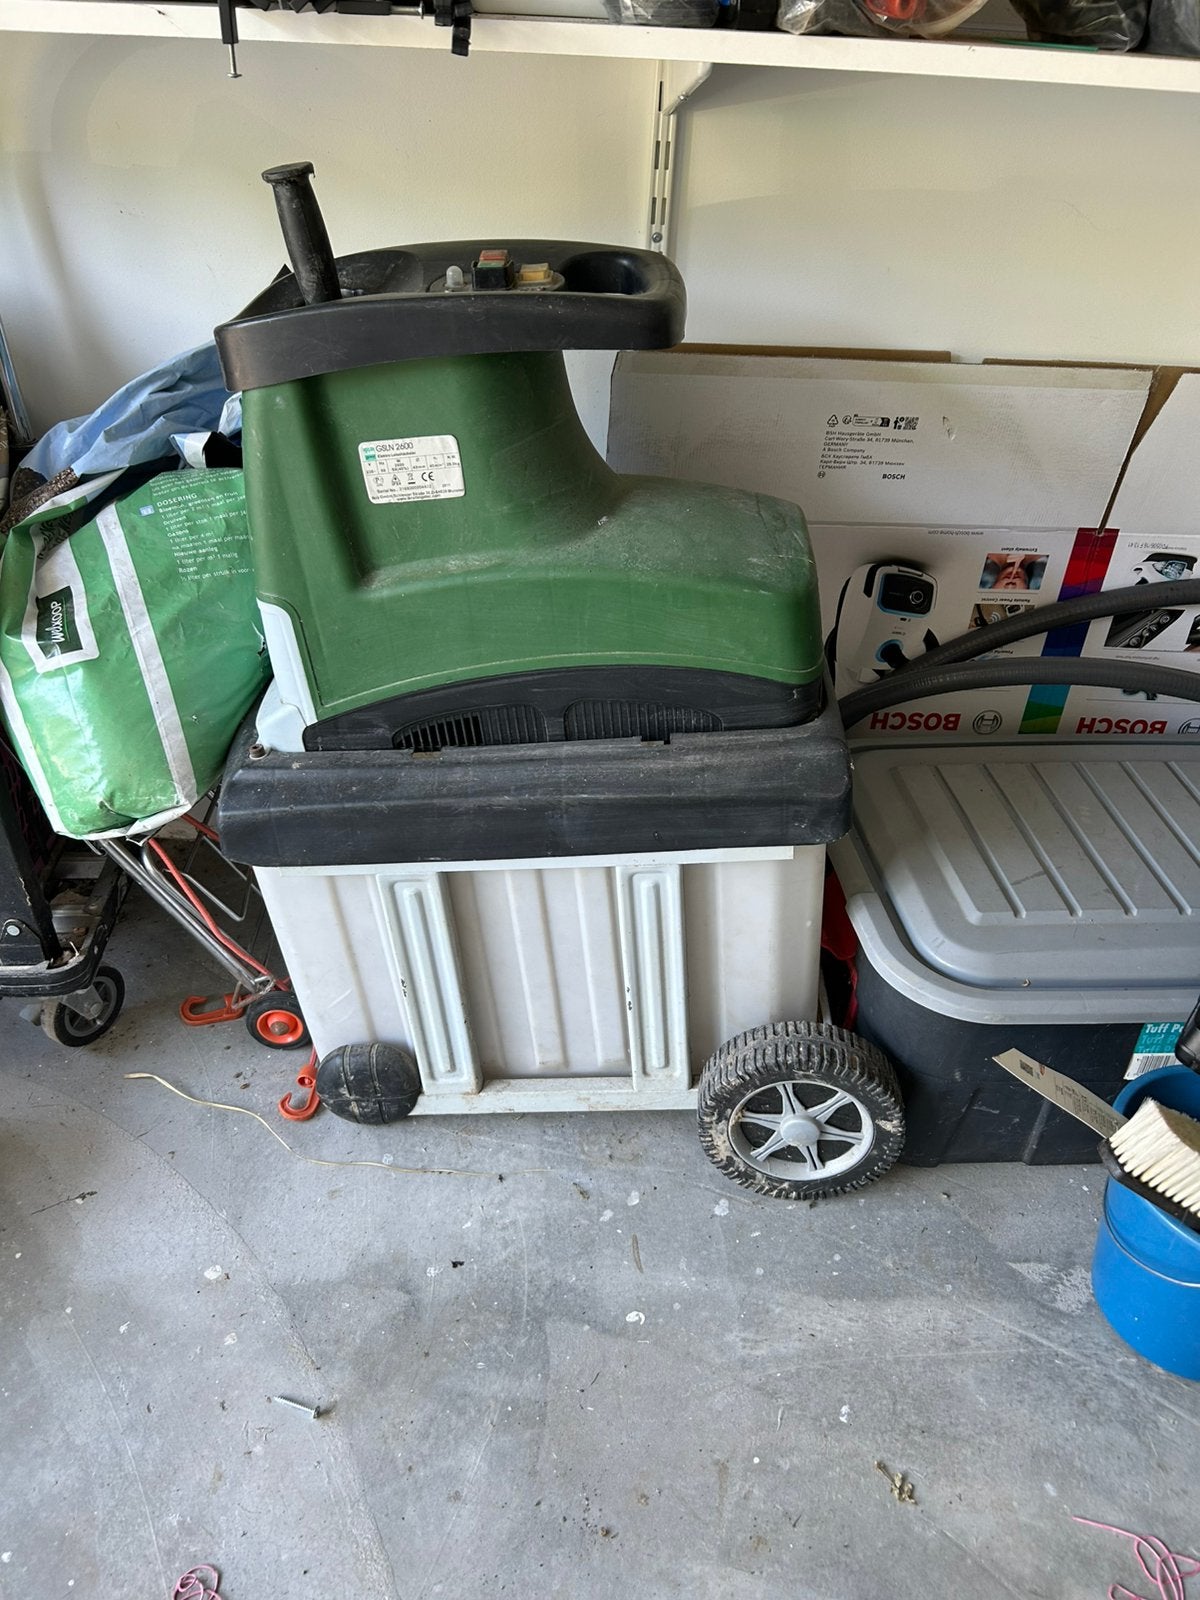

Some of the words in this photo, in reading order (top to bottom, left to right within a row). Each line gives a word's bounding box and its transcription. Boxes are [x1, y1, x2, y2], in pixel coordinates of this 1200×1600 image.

[376, 444, 394, 452] GSLN
[396, 442, 414, 451] 2600
[157, 493, 198, 507] DOSERING
[870, 712, 961, 731] BOSCH
[1075, 717, 1168, 734] BOSCH
[1145, 1023, 1170, 1034] Tuff
